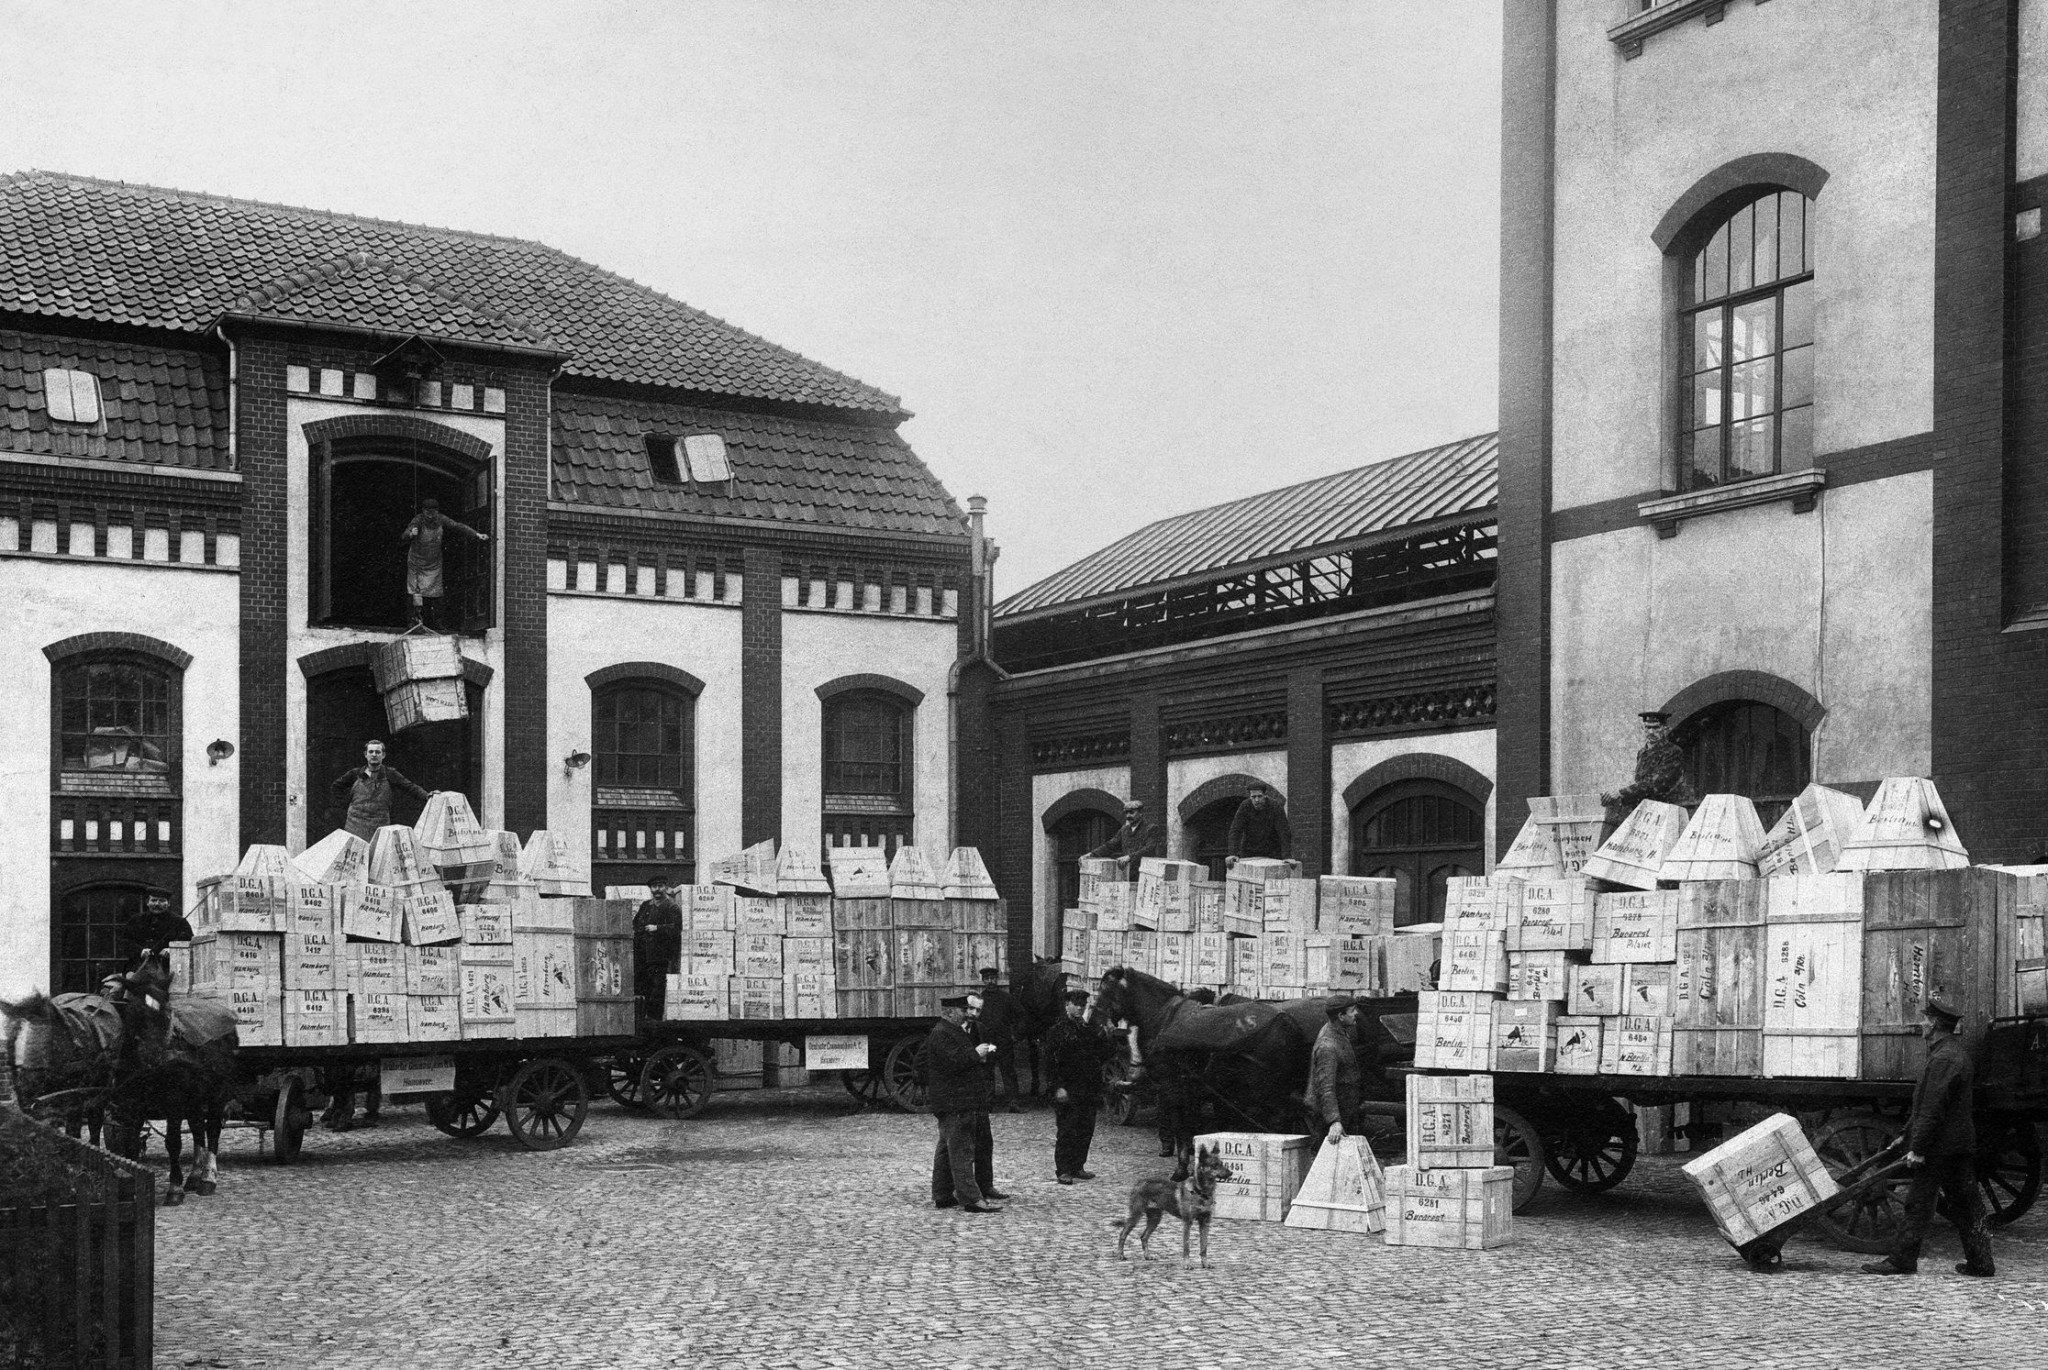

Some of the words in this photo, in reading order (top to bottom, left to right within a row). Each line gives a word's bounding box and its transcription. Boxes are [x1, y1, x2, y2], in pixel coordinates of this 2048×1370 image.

[1552, 835, 1592, 845] Hamburg
[1605, 841, 1644, 860] Hamburg
[495, 863, 523, 877] Berlin
[239, 907, 271, 917] Hamburg
[359, 904, 391, 919] Hamburg
[1459, 910, 1491, 919] Hamburg
[1532, 907, 1550, 915] 6280
[298, 914, 323, 922] Hamburg
[1339, 914, 1371, 924] Hamburg
[420, 923, 447, 932] Hamburg
[1611, 927, 1651, 938] Bucarest
[234, 966, 260, 976] Hamburg
[300, 962, 330, 972] Hamburg
[1451, 963, 1475, 975] Berlin
[363, 970, 391, 978] Hamburg
[421, 974, 444, 983] Berlin
[542, 955, 552, 996] Hamburg
[1340, 969, 1364, 979] Hamburg
[1909, 945, 1924, 1004] Hamburg
[1533, 968, 1541, 1000] Berlin
[1700, 966, 1717, 1000] Cöln
[482, 974, 492, 1015] Hamburg
[1794, 982, 1807, 1008] Cöln
[300, 1023, 330, 1031] Hamburg
[420, 1020, 446, 1029] Hamburg
[1435, 1037, 1464, 1048] Berlin
[1462, 1103, 1472, 1145] Bucarest
[1748, 1158, 1788, 1187] Berlin
[1418, 1197, 1439, 1209] 6281
[1404, 1209, 1445, 1222] Bucarest
